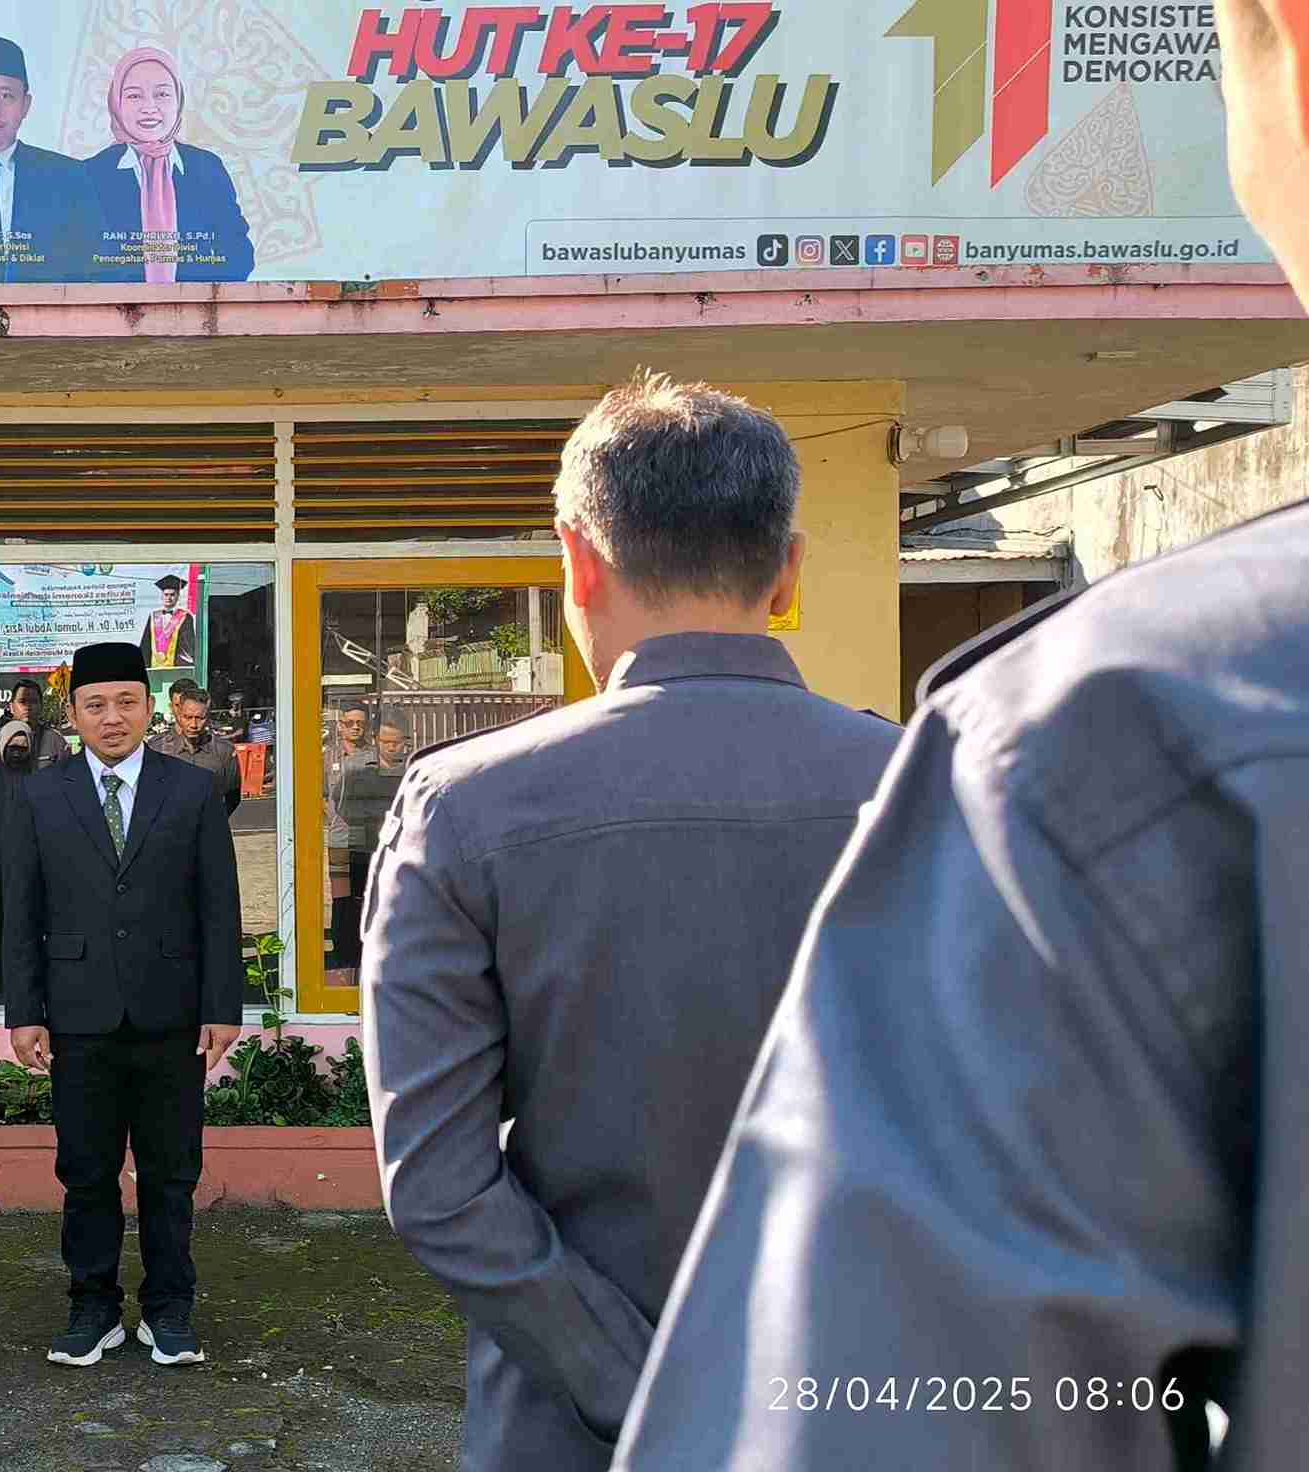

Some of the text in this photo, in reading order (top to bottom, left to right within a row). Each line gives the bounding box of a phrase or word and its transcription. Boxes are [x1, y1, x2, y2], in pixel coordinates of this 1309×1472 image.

[1064, 5, 1215, 28] KONSISTE
[347, 2, 780, 83] HUT KE-17
[1063, 32, 1221, 55] MENGAWA
[1063, 59, 1222, 83] DEMOKRA
[291, 74, 839, 169] BAWASLU
[102, 231, 127, 241] RANI
[542, 242, 746, 264] bawaslubanyumas
[965, 239, 1240, 262] banyumas.bawaslu.go.id
